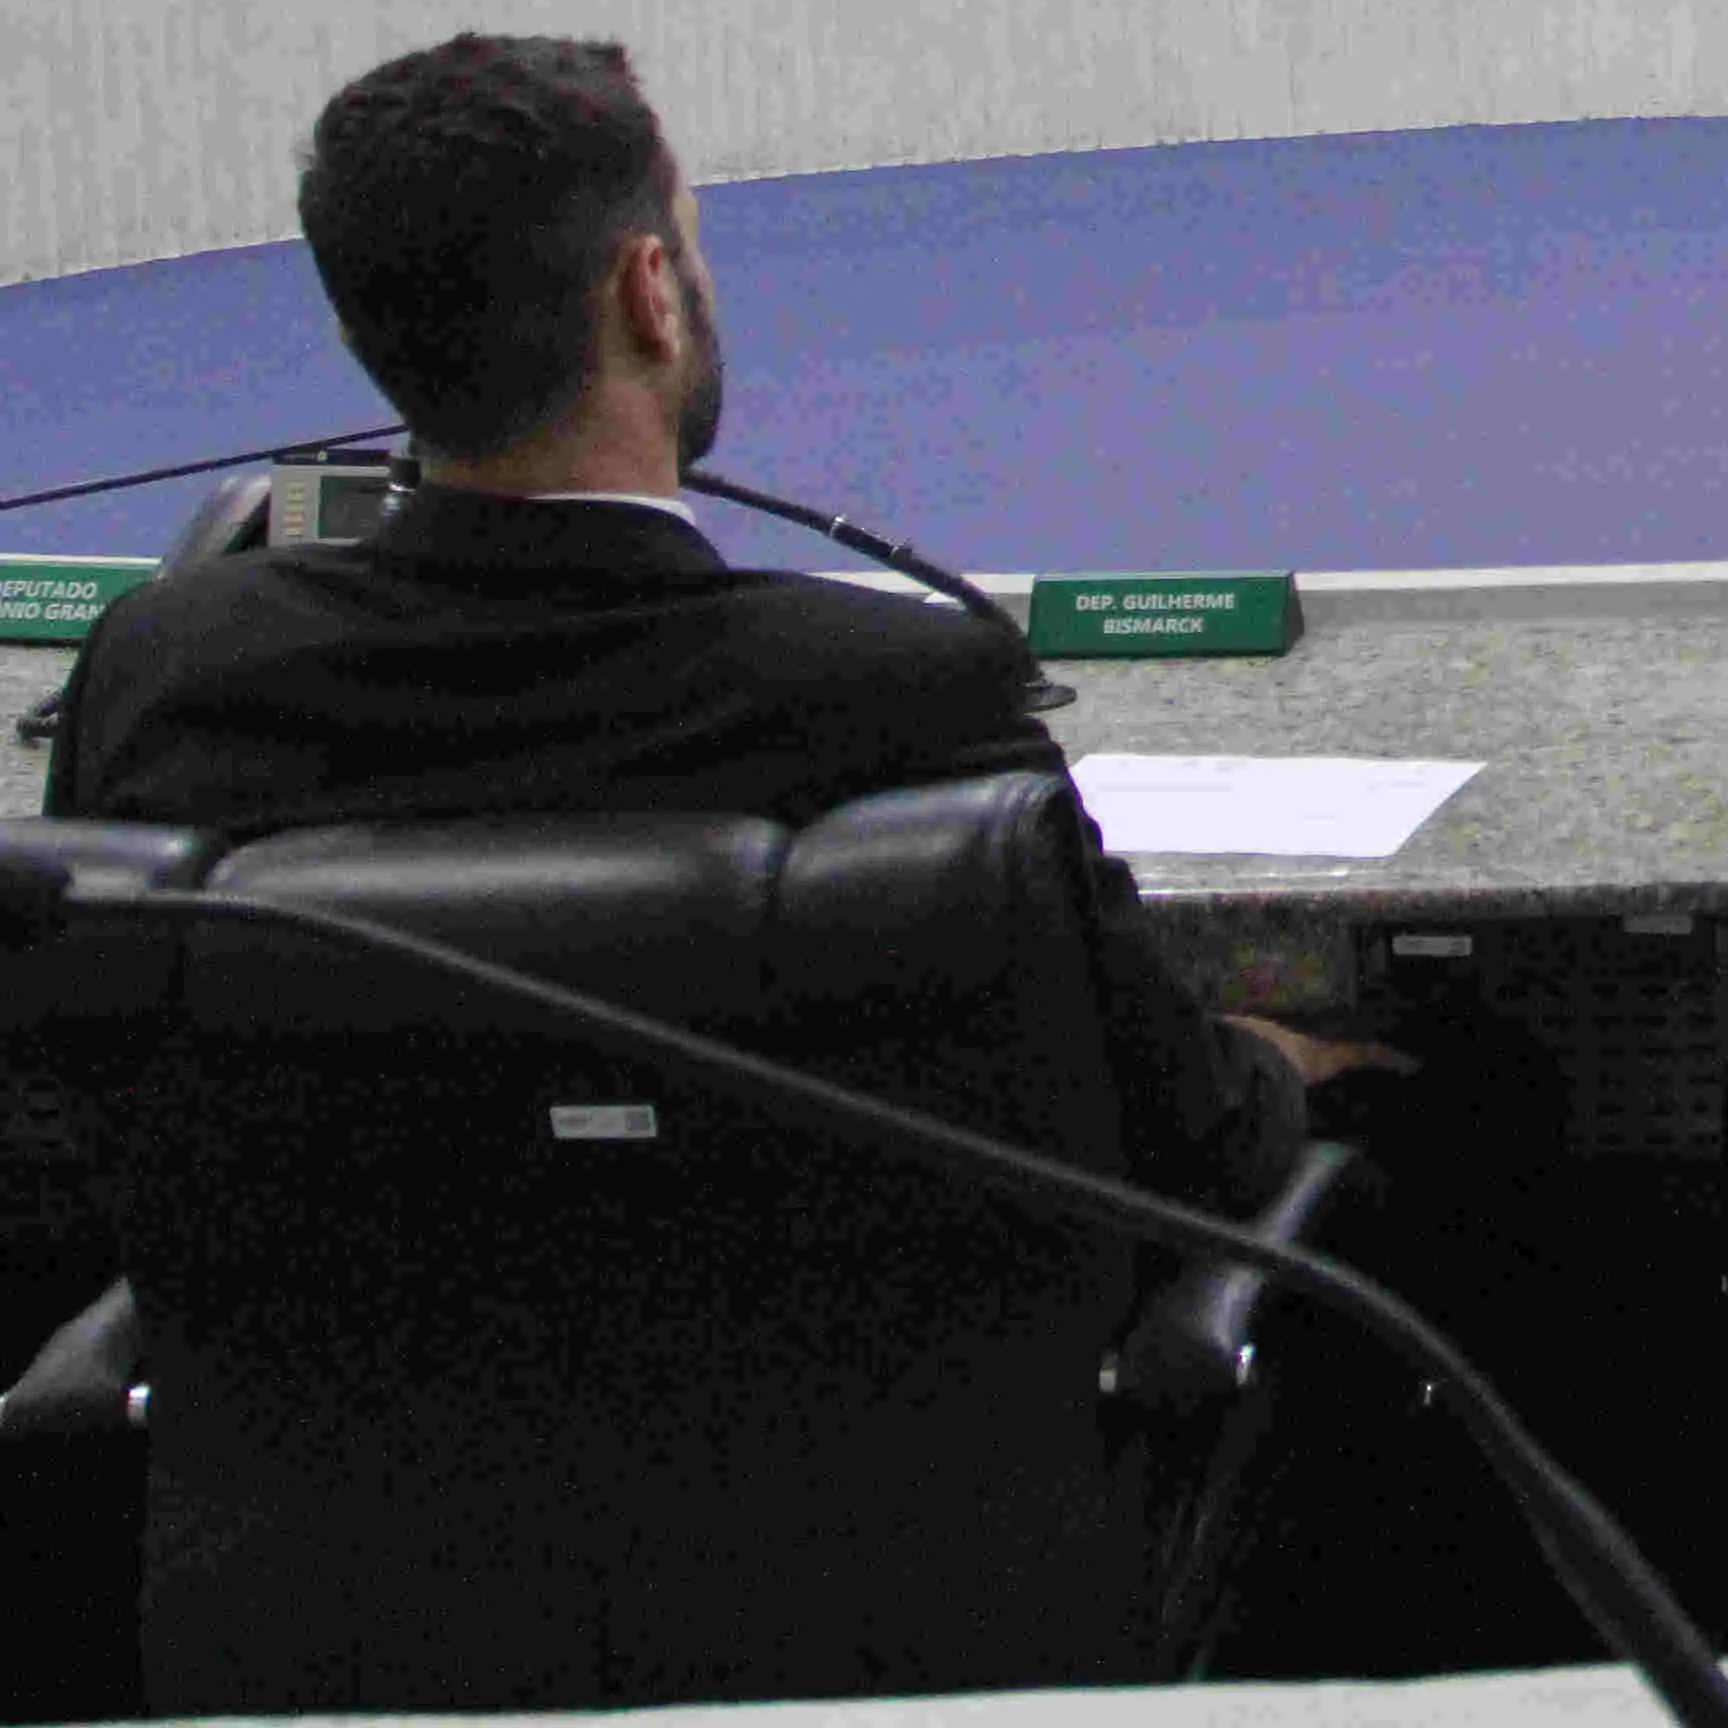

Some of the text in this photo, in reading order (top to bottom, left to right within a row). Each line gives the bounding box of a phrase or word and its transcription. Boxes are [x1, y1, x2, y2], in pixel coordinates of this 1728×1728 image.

[0, 580, 98, 599] EPUTADO
[1075, 592, 1236, 611] DEP. GUILHERME
[0, 602, 106, 621] NIO GRAN
[1103, 617, 1205, 635] BISMARCK
